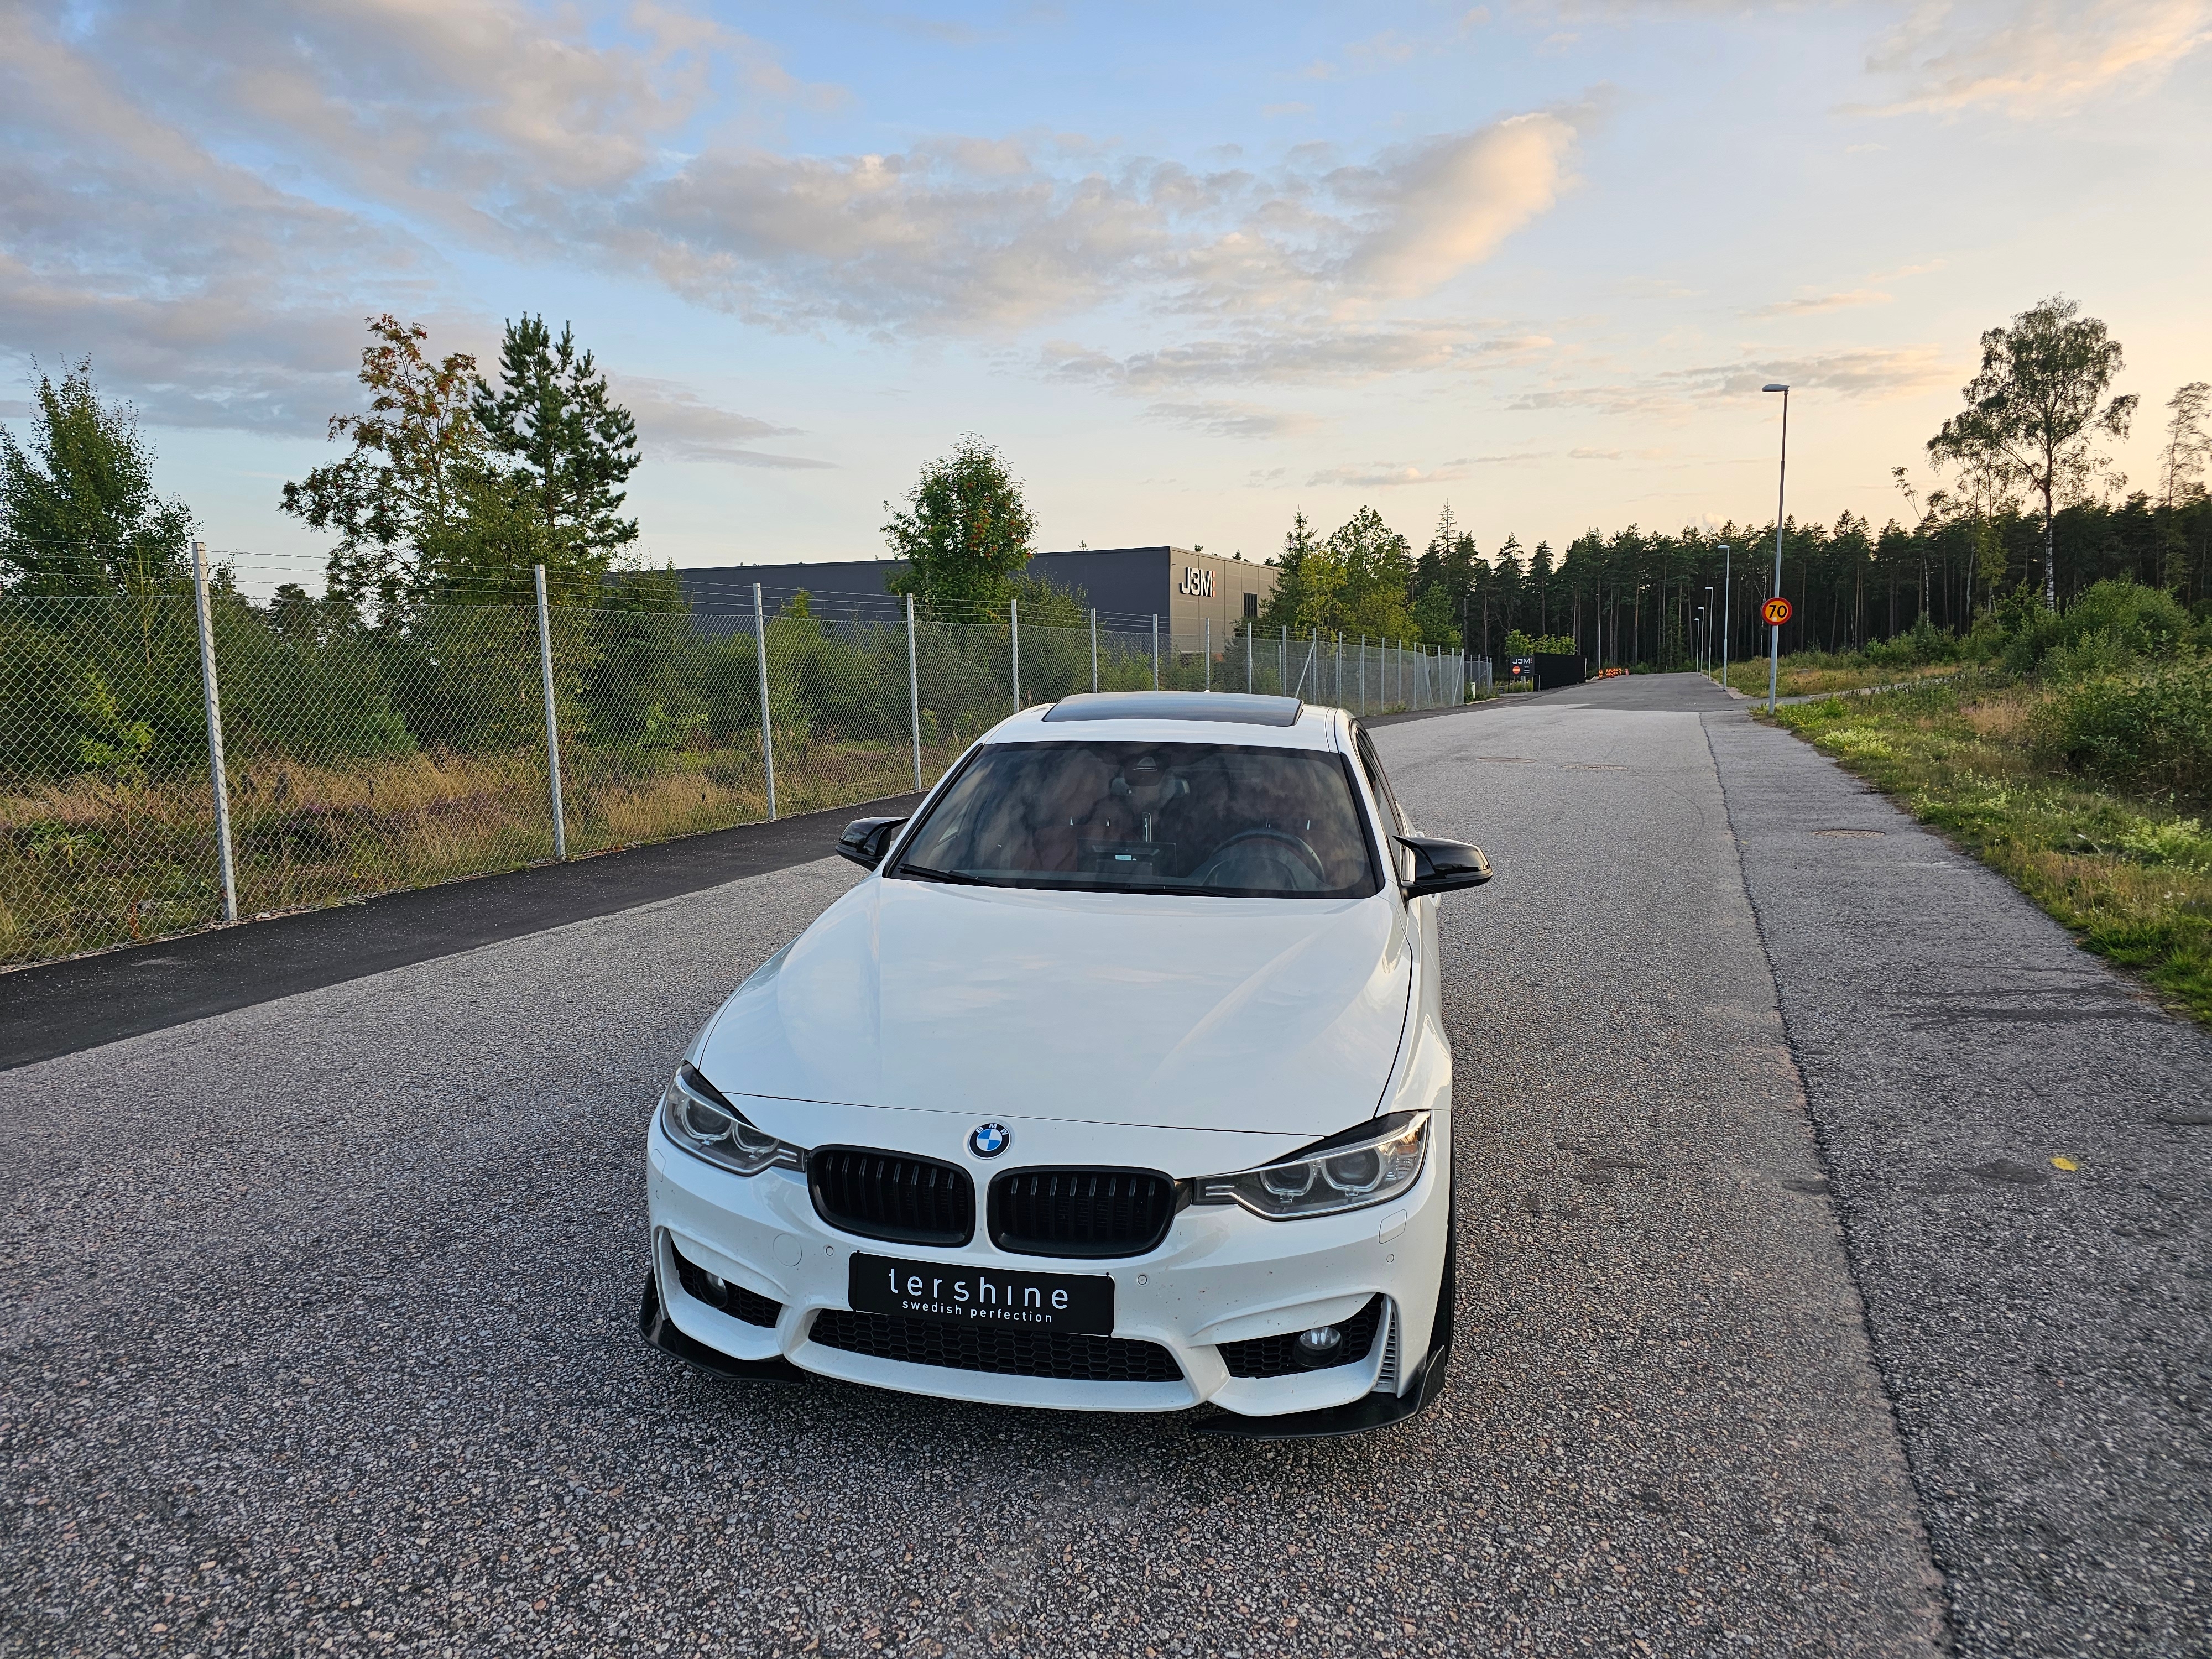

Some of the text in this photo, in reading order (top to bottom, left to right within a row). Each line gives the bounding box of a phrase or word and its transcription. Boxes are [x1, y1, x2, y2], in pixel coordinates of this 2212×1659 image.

[1181, 567, 1213, 597] J3M
[1769, 605, 1787, 618] 70
[975, 1123, 1008, 1135] BMW
[889, 1268, 1068, 1310] tershine
[902, 1301, 1052, 1323] swedish perfection
